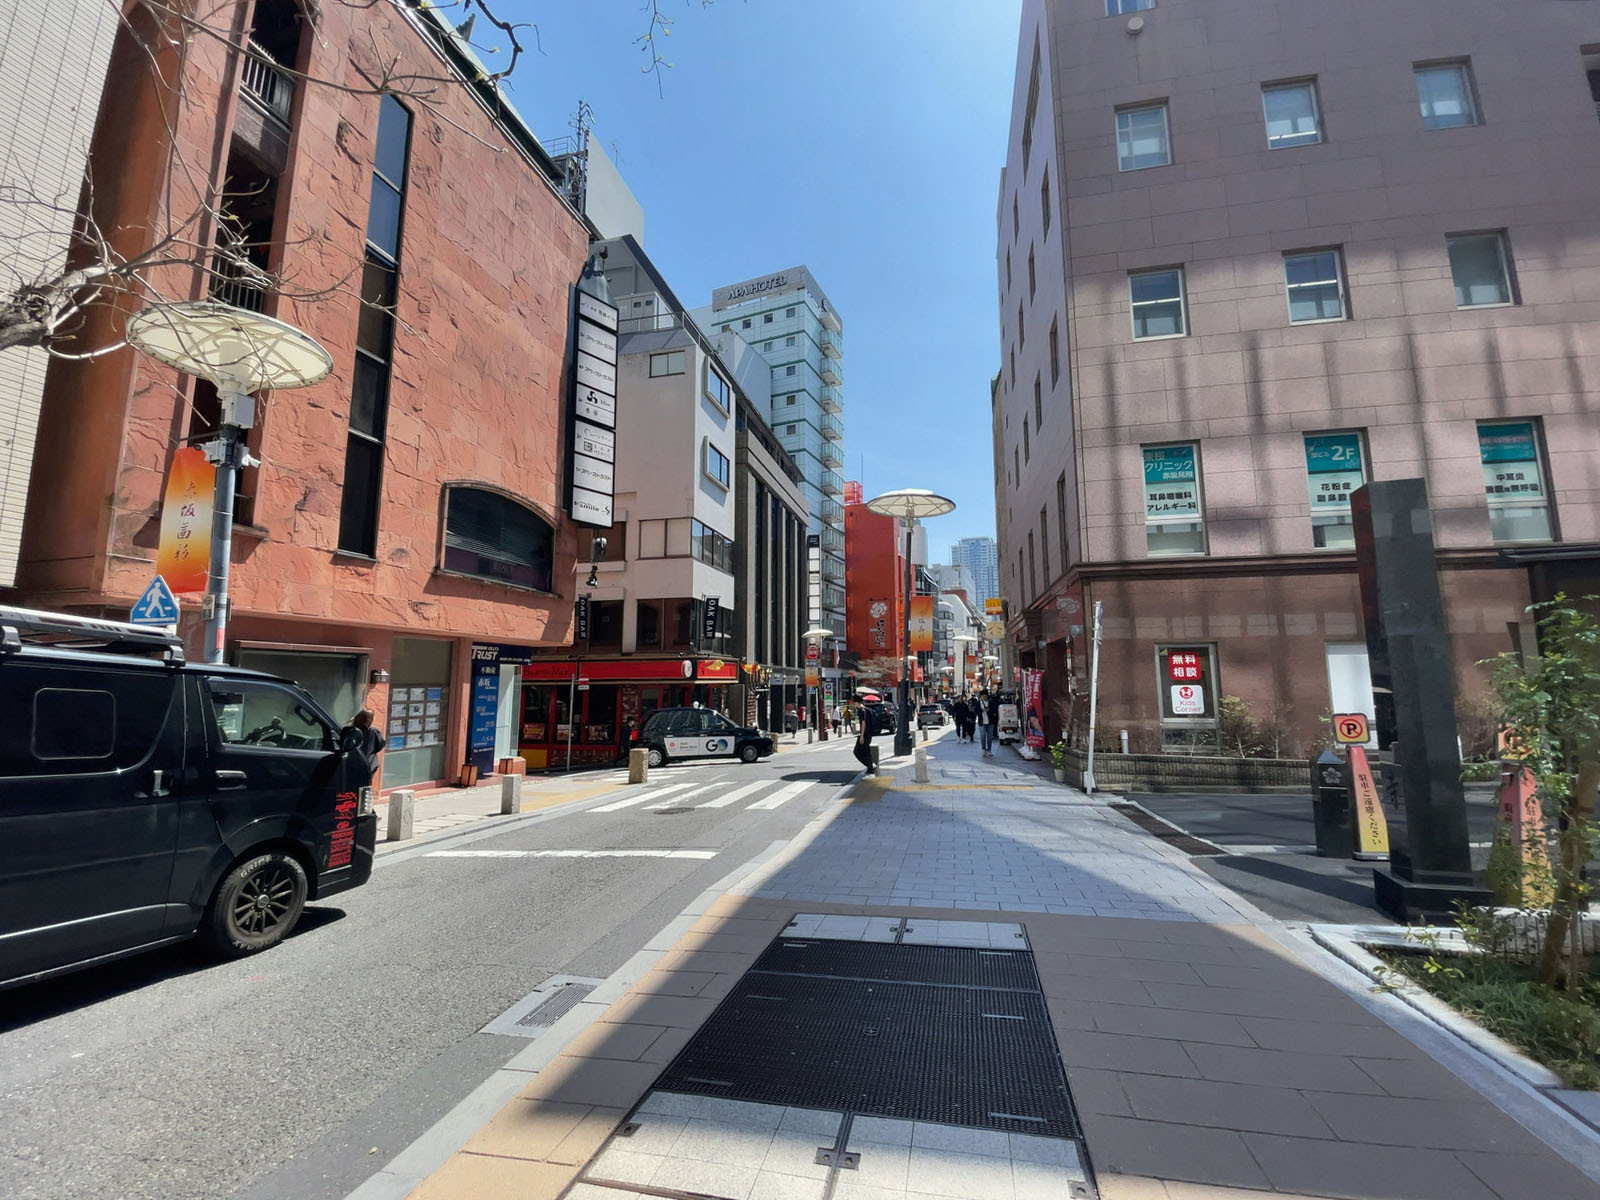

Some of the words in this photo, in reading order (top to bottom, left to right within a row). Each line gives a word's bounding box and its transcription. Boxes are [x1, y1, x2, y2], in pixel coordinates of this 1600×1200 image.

[728, 285, 749, 300] APA
[750, 275, 788, 294] HOTEL
[1331, 445, 1355, 461] 2F
[1144, 460, 1193, 473] クリニック
[1320, 482, 1352, 492] 花粉症
[1146, 502, 1197, 512] アレルギー科
[579, 599, 587, 617] OAK
[707, 599, 716, 617] OAK
[579, 620, 587, 638] BAR
[706, 620, 714, 638] BAR
[472, 646, 499, 660] TRUST
[1172, 654, 1197, 665] 無料
[1173, 667, 1198, 678] 相談
[1175, 705, 1202, 713] Corner
[705, 738, 729, 753] GO
